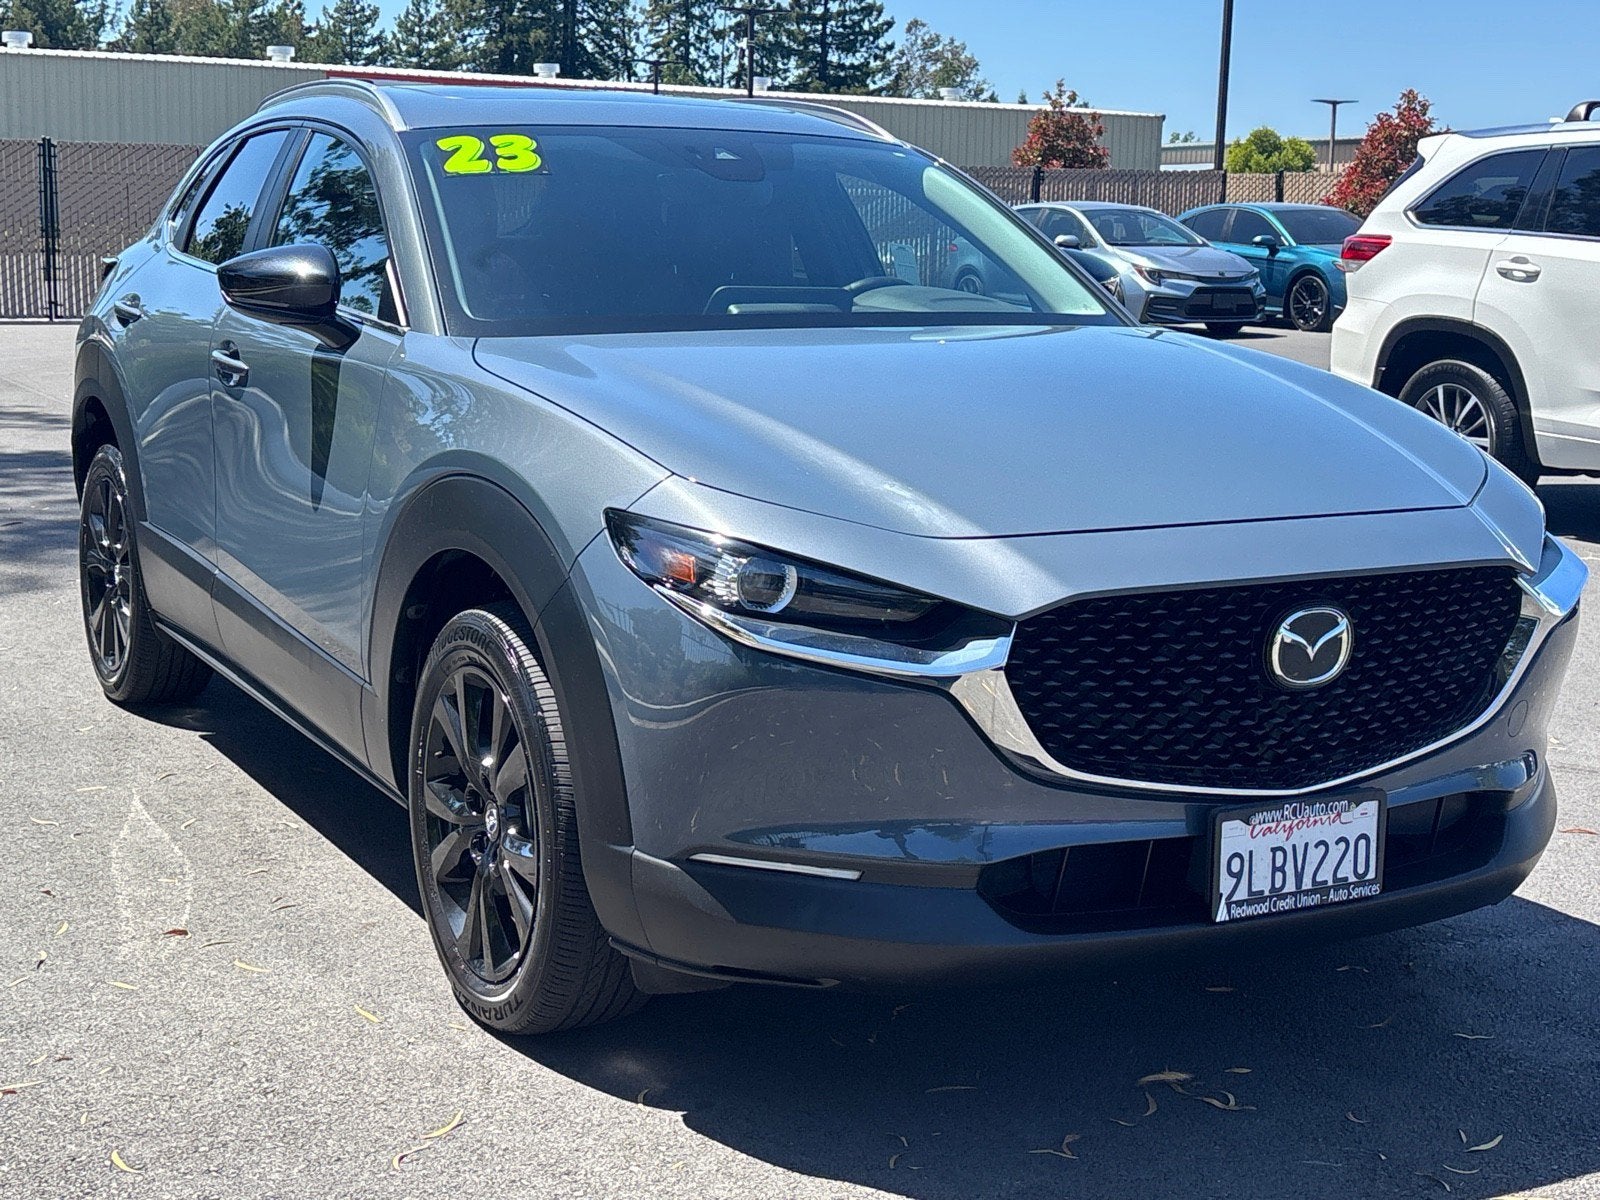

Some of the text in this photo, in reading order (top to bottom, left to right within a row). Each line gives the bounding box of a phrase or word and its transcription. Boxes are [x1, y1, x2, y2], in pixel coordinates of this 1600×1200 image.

[436, 134, 541, 174] 23
[1250, 813, 1352, 841] California
[1255, 800, 1349, 824] www.RCUauto.com
[1225, 833, 1371, 901] 9LBV220
[1230, 902, 1269, 919] Redwood
[1270, 896, 1295, 912] Credit
[1297, 892, 1321, 908] Union
[1328, 887, 1348, 902] Auto
[1349, 883, 1380, 899] Services
